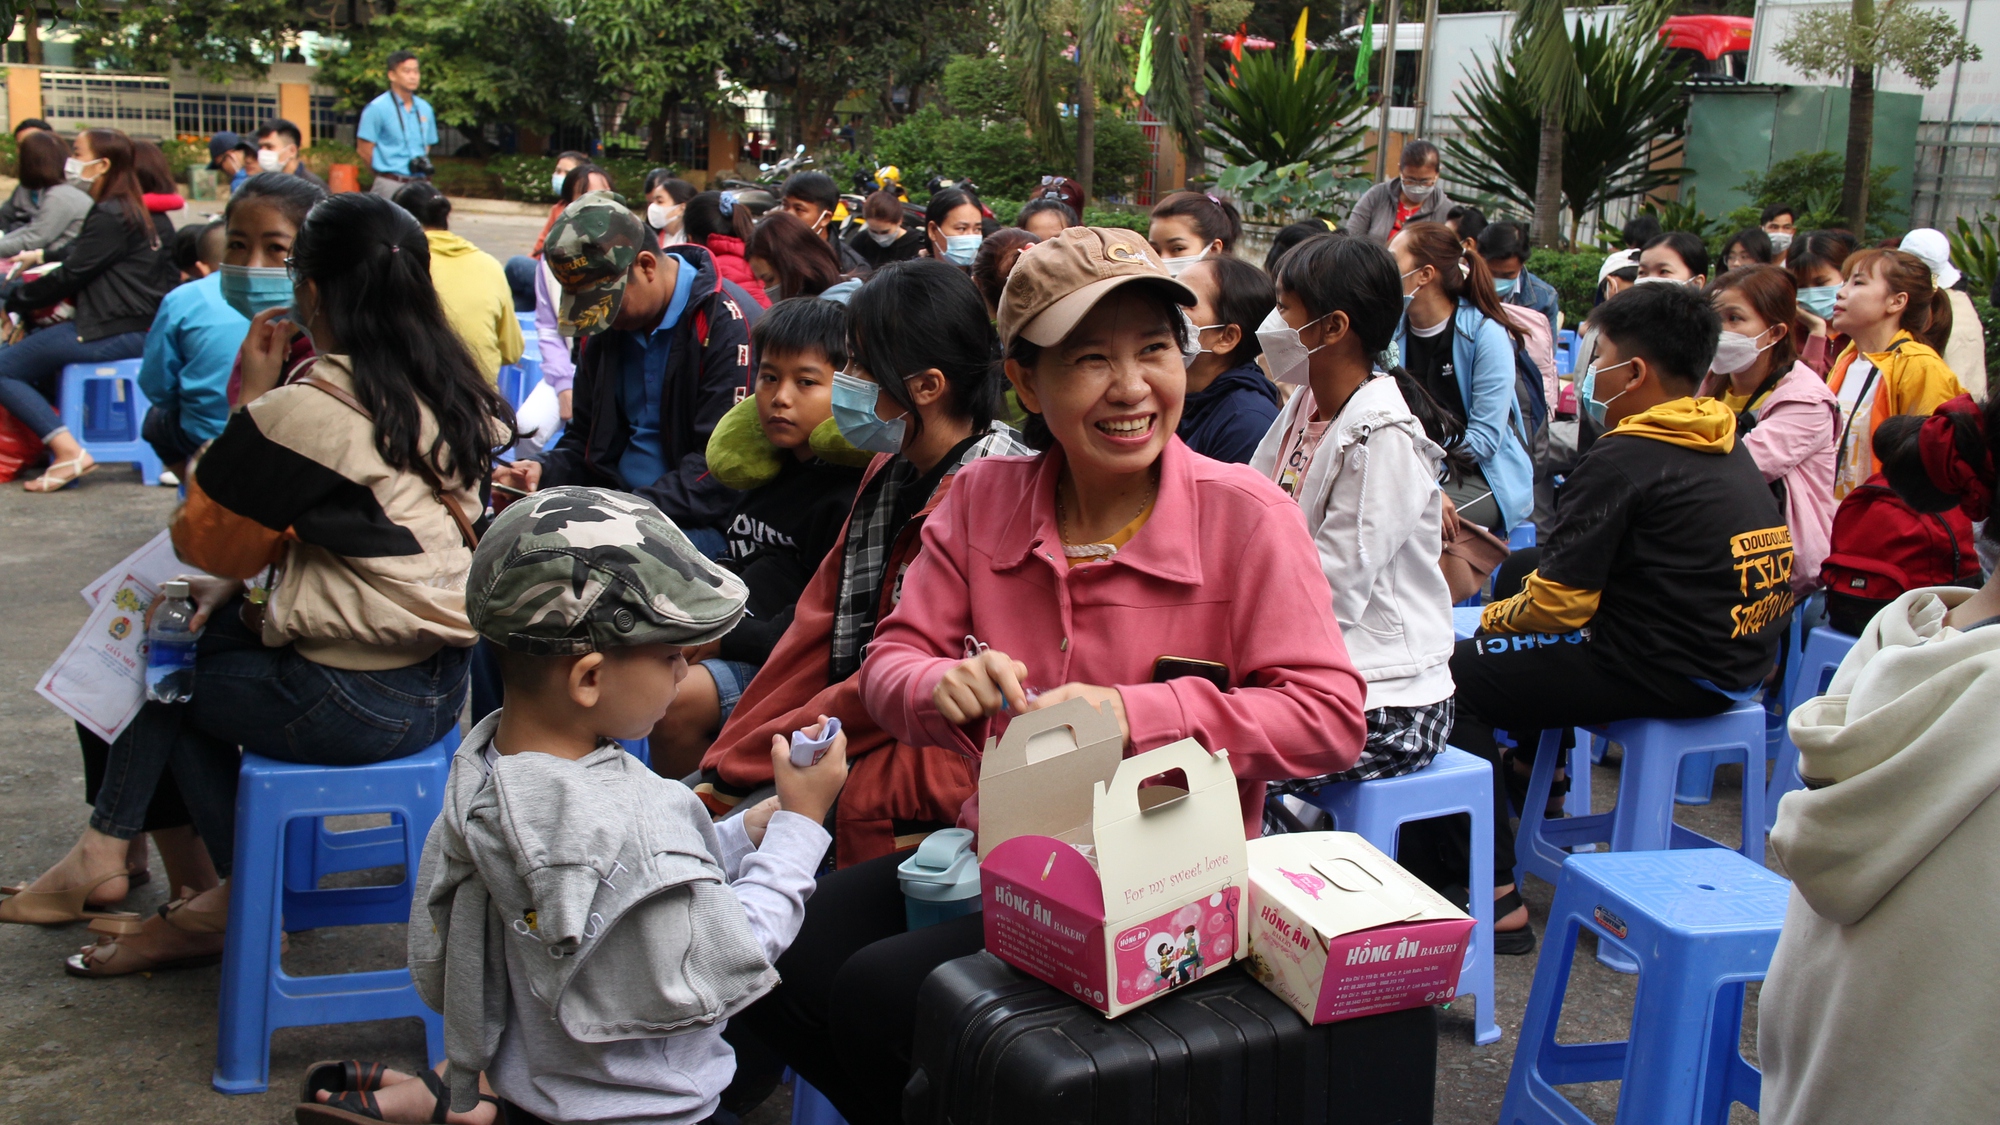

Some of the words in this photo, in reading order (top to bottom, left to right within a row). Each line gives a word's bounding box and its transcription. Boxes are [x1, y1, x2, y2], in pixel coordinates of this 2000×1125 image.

[1124, 886, 1145, 905] For
[1149, 878, 1166, 895] my
[1169, 862, 1202, 887] sweet
[1205, 854, 1229, 873] love
[995, 884, 1030, 916] HỒNG
[1033, 899, 1052, 927] ÂN
[1053, 921, 1087, 943] BAKERY
[1260, 905, 1291, 937] HỒNG
[1292, 927, 1311, 950] ÂN
[1272, 931, 1293, 948] BAKERY
[1345, 938, 1393, 966] HỒNG
[1394, 936, 1420, 959] ÂN
[1420, 942, 1459, 957] BAKERY
